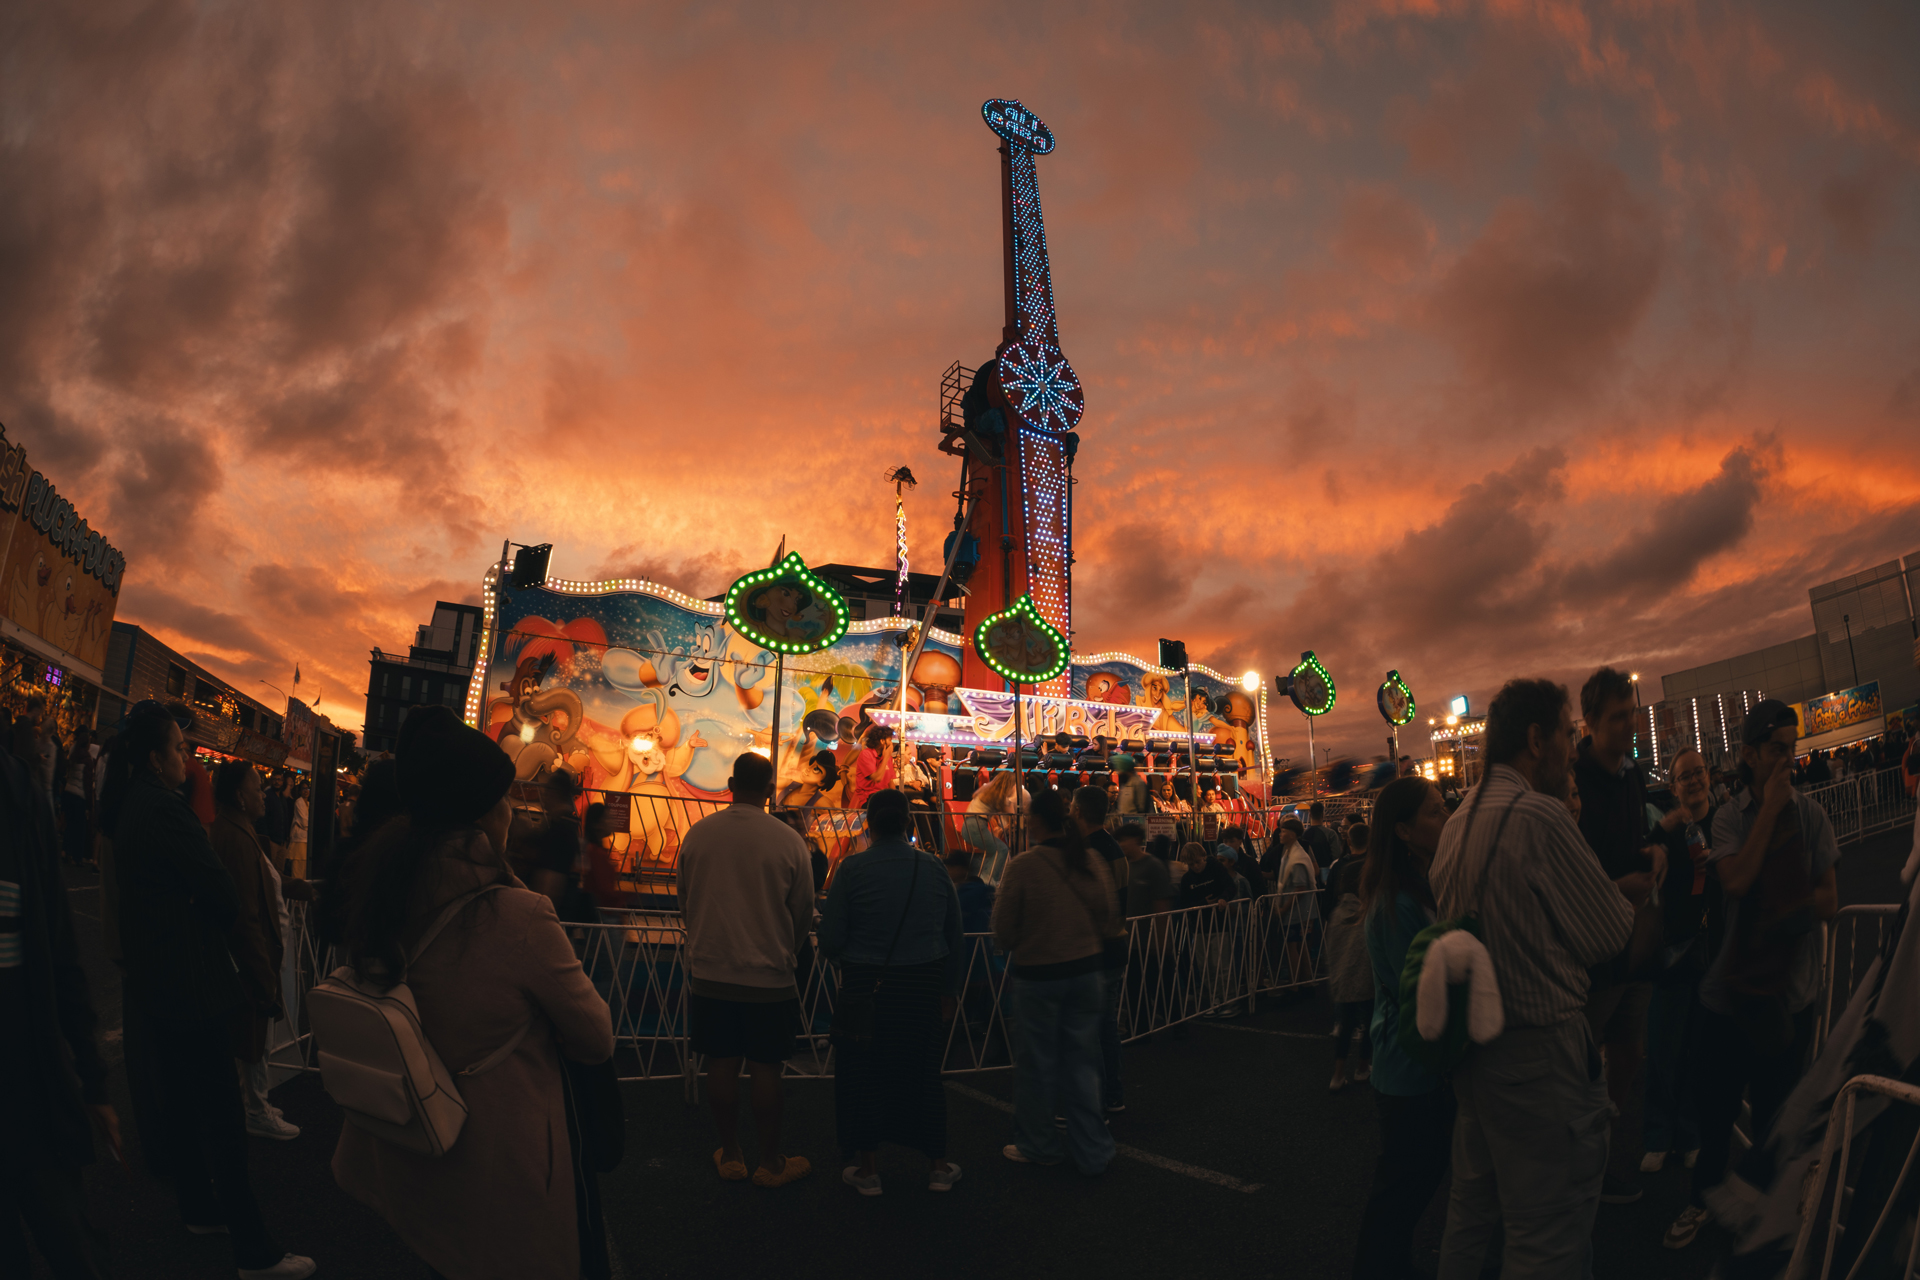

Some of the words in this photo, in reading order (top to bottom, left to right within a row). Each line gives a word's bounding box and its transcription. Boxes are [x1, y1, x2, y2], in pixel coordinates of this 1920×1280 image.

[973, 699, 1058, 742] Ali
[1063, 704, 1144, 744] Baba
[1815, 707, 1837, 728] Fish
[1848, 697, 1879, 719] Friend
